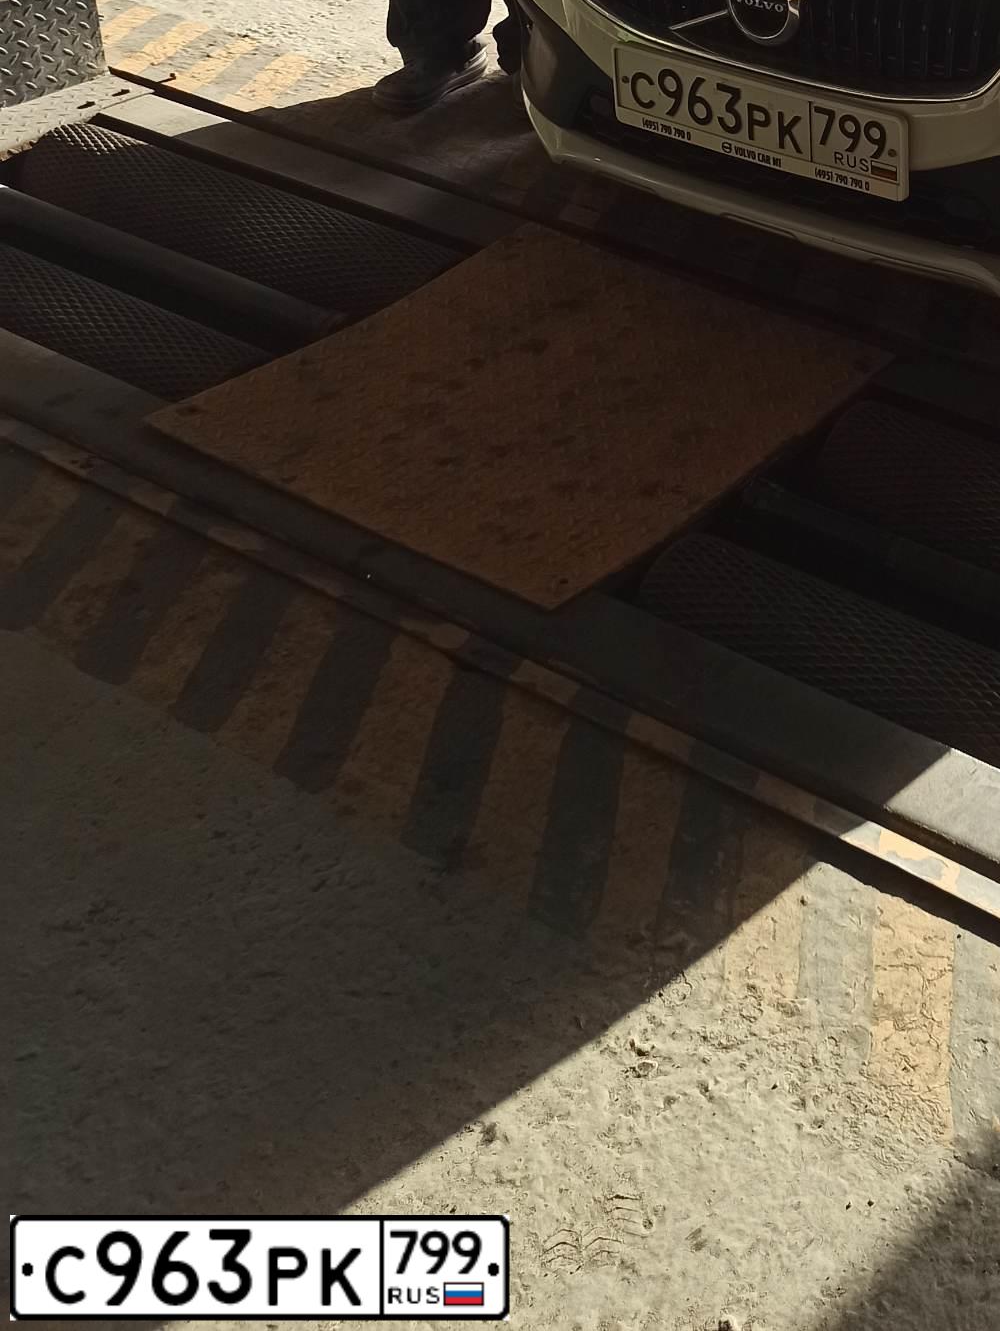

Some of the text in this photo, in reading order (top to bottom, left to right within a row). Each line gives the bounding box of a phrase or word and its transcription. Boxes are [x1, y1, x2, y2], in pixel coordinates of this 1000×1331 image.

[660, 124, 672, 135] 790
[673, 127, 686, 139] 790
[812, 106, 887, 159] 799
[734, 145, 756, 160] VOLVO
[757, 152, 771, 165] CAR
[834, 151, 869, 173] RUS
[834, 173, 848, 185] 790
[849, 176, 863, 189] 790
